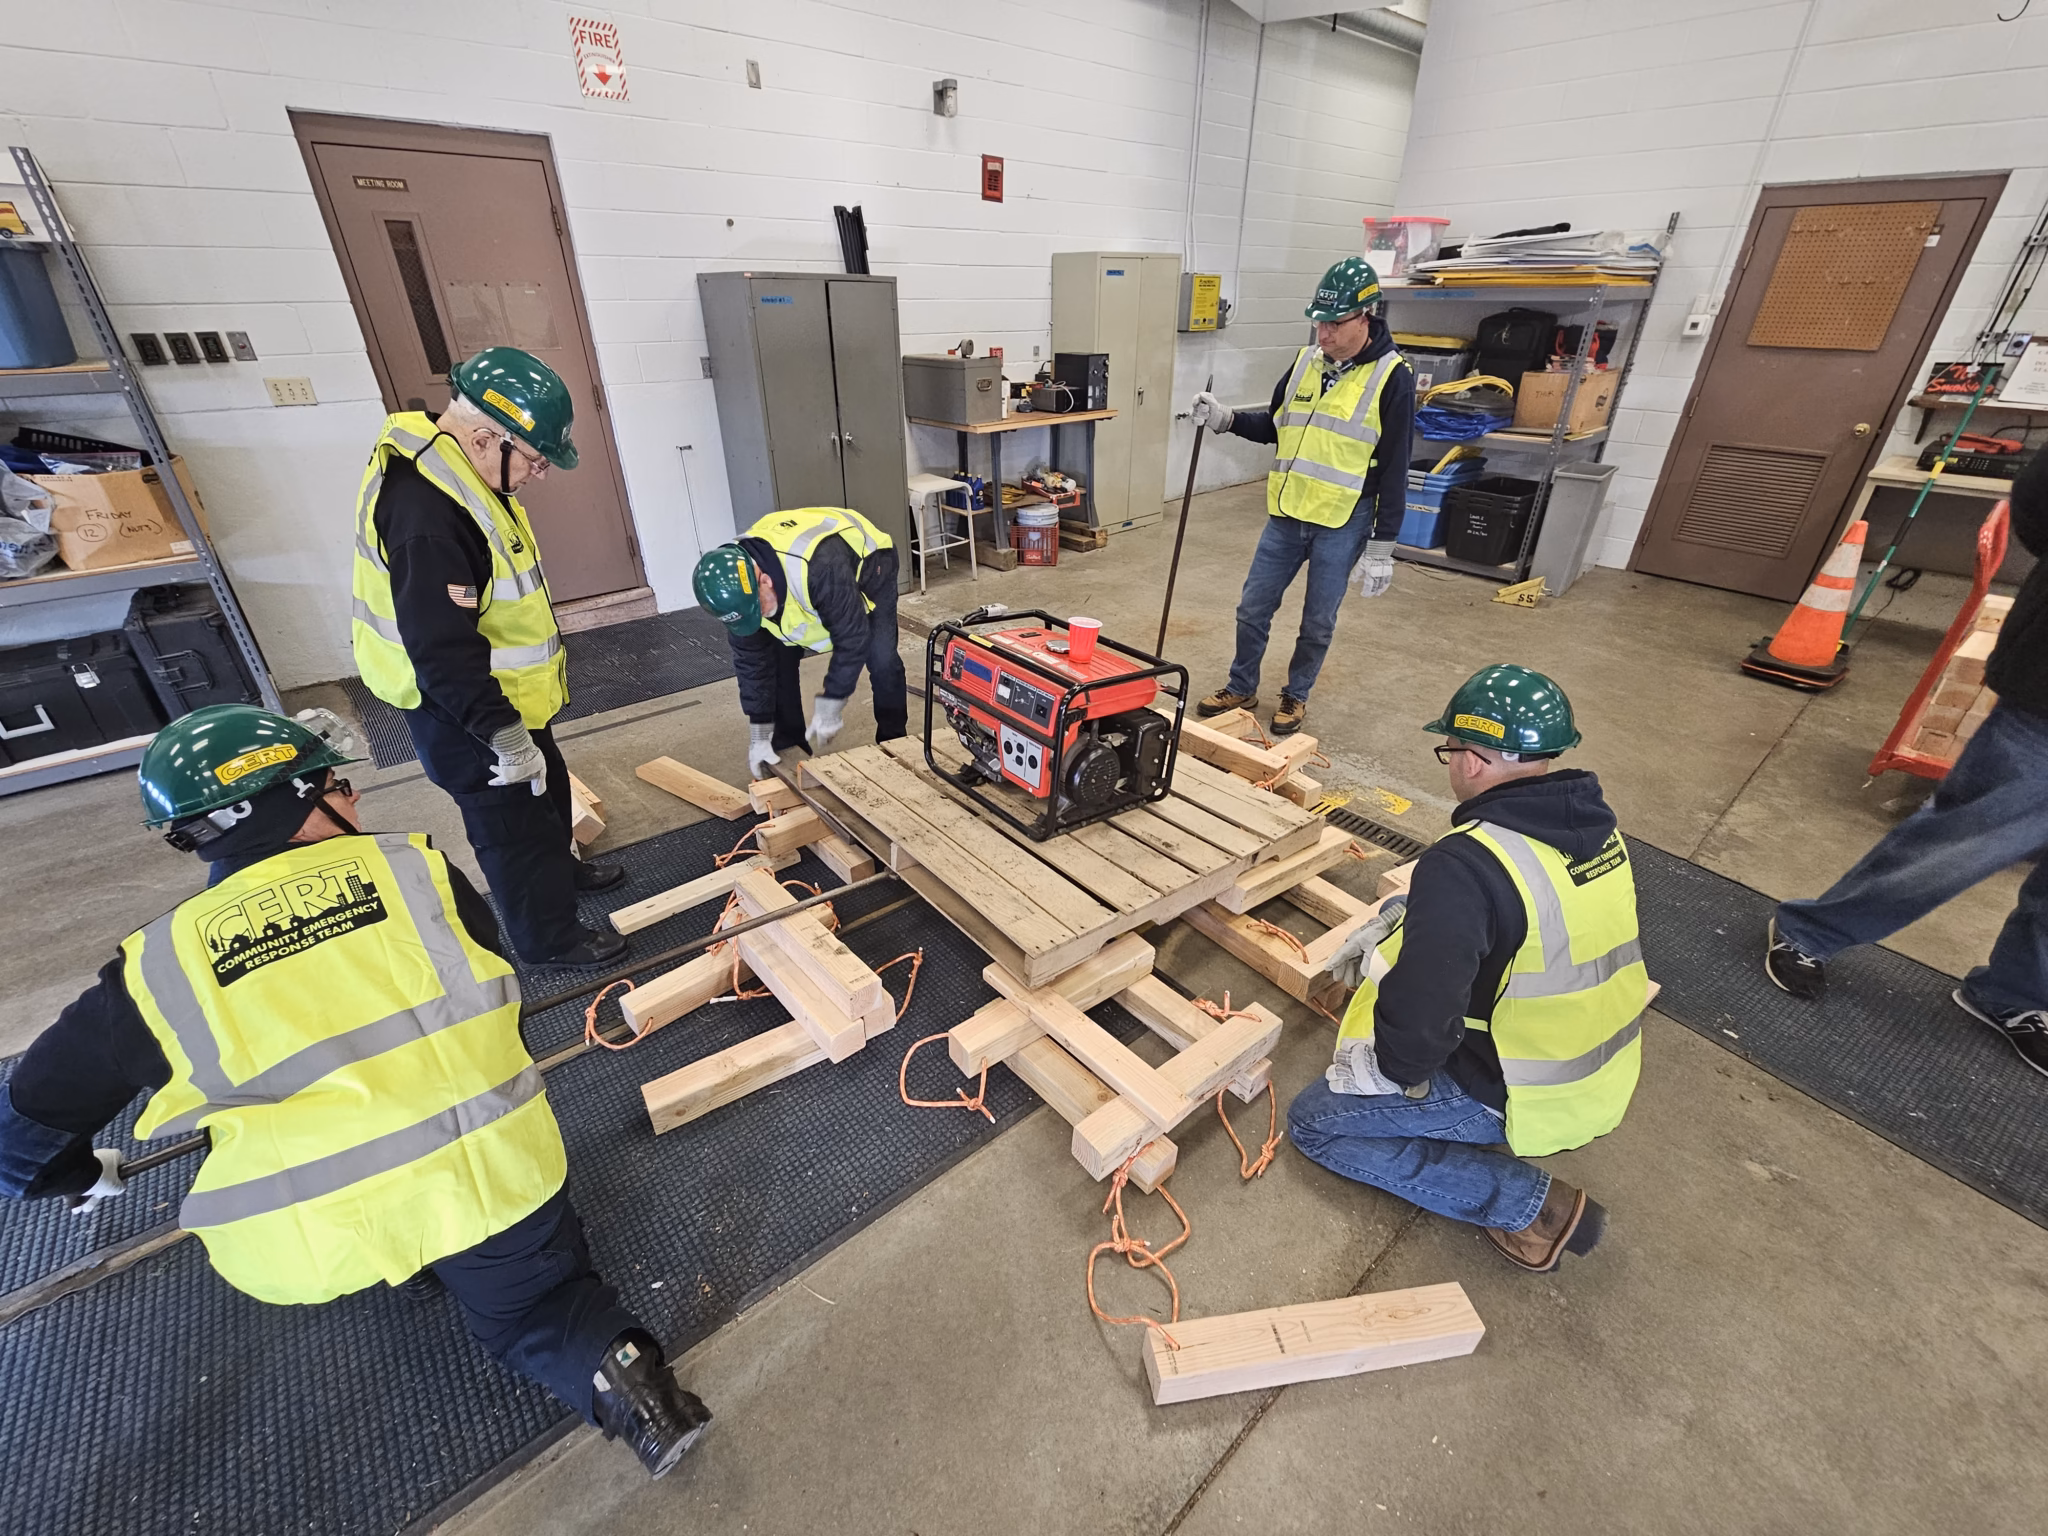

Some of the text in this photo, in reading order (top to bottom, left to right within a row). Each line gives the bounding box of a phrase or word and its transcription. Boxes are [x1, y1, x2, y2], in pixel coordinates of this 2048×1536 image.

[579, 30, 613, 49] FIRE
[356, 178, 405, 189] MEETING ROOM
[1950, 365, 1977, 379] N
[485, 391, 534, 427] CERT
[85, 509, 132, 521] FRIDAY
[84, 529, 99, 538] 12
[1456, 715, 1503, 735] CERT
[221, 745, 293, 779] CERT
[1569, 856, 1603, 876] COMMUNITY
[1585, 862, 1612, 879] RESPONSE
[205, 860, 366, 942] CERT
[216, 901, 379, 974] COMMUNITY EMERGENCY
[245, 920, 355, 970] RESPONSE TEAM
